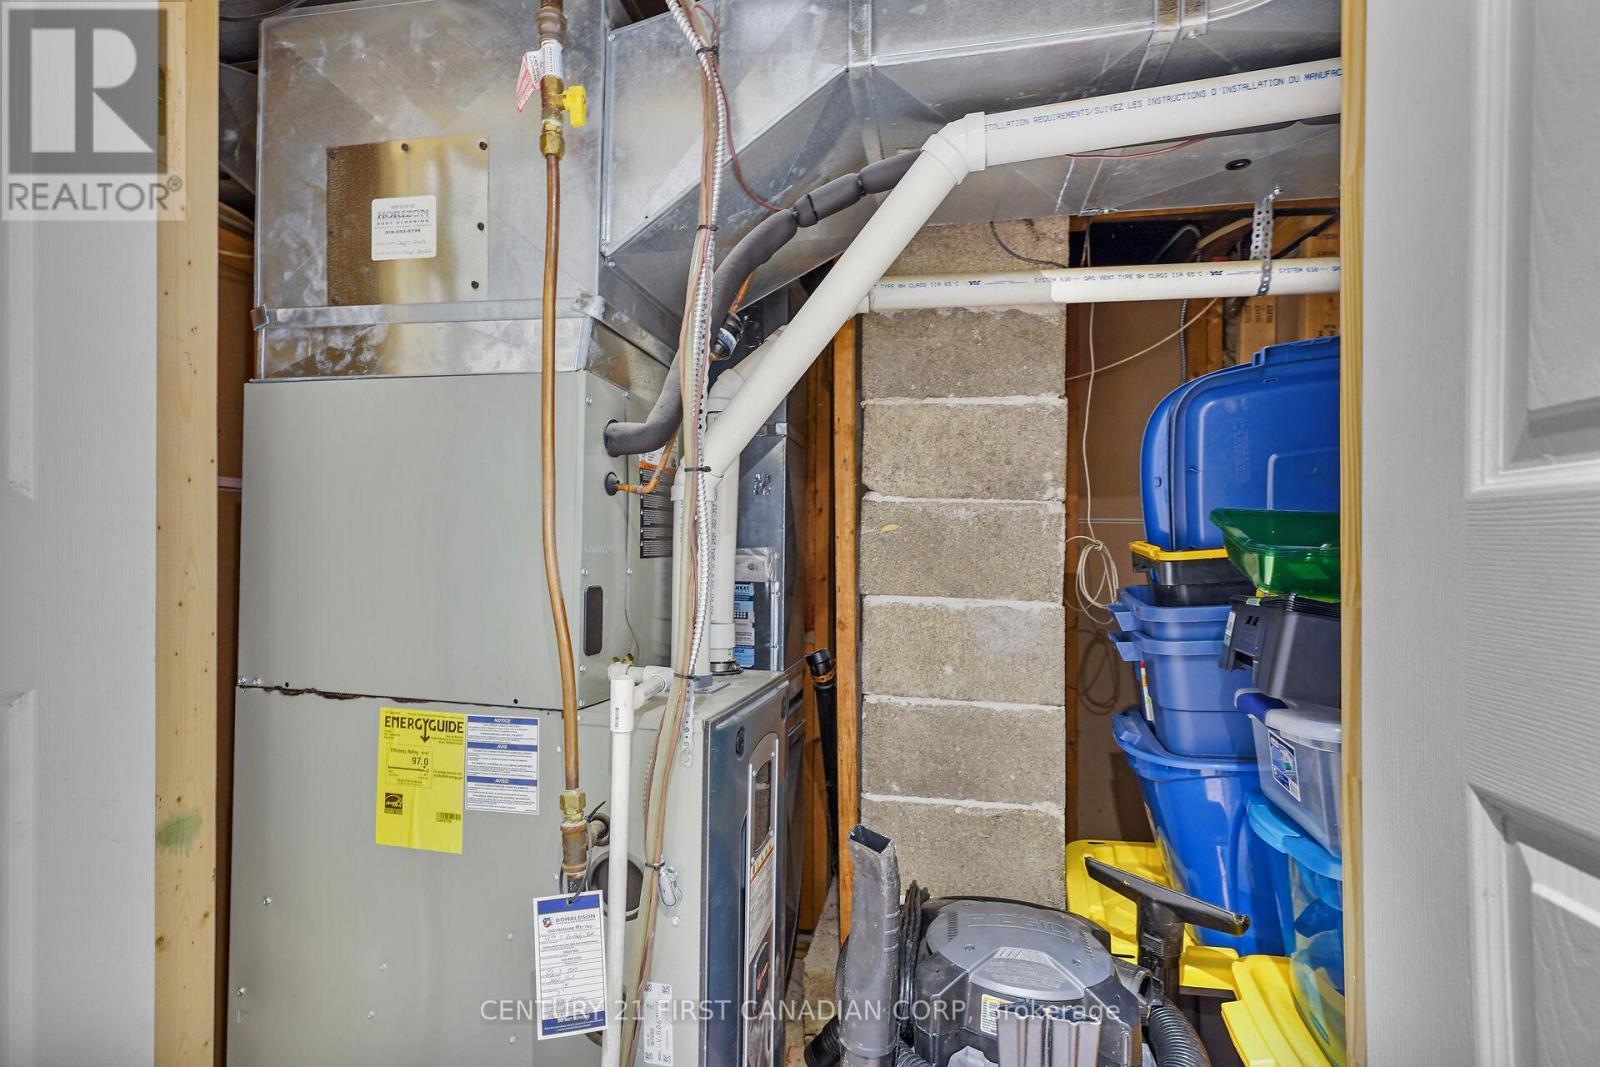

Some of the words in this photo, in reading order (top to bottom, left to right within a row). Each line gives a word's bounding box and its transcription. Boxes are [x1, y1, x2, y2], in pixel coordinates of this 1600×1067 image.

[1127, 100, 1143, 110] LES
[1148, 90, 1206, 106] INSTRUCTIONS
[1288, 75, 1300, 85] DU
[377, 209, 429, 219] HORIZON
[1278, 265, 1303, 274] SYSTEM
[384, 715, 464, 735] ENERGYGUIDE
[411, 756, 429, 766] 97.0
[555, 914, 596, 923] DONALDSON
